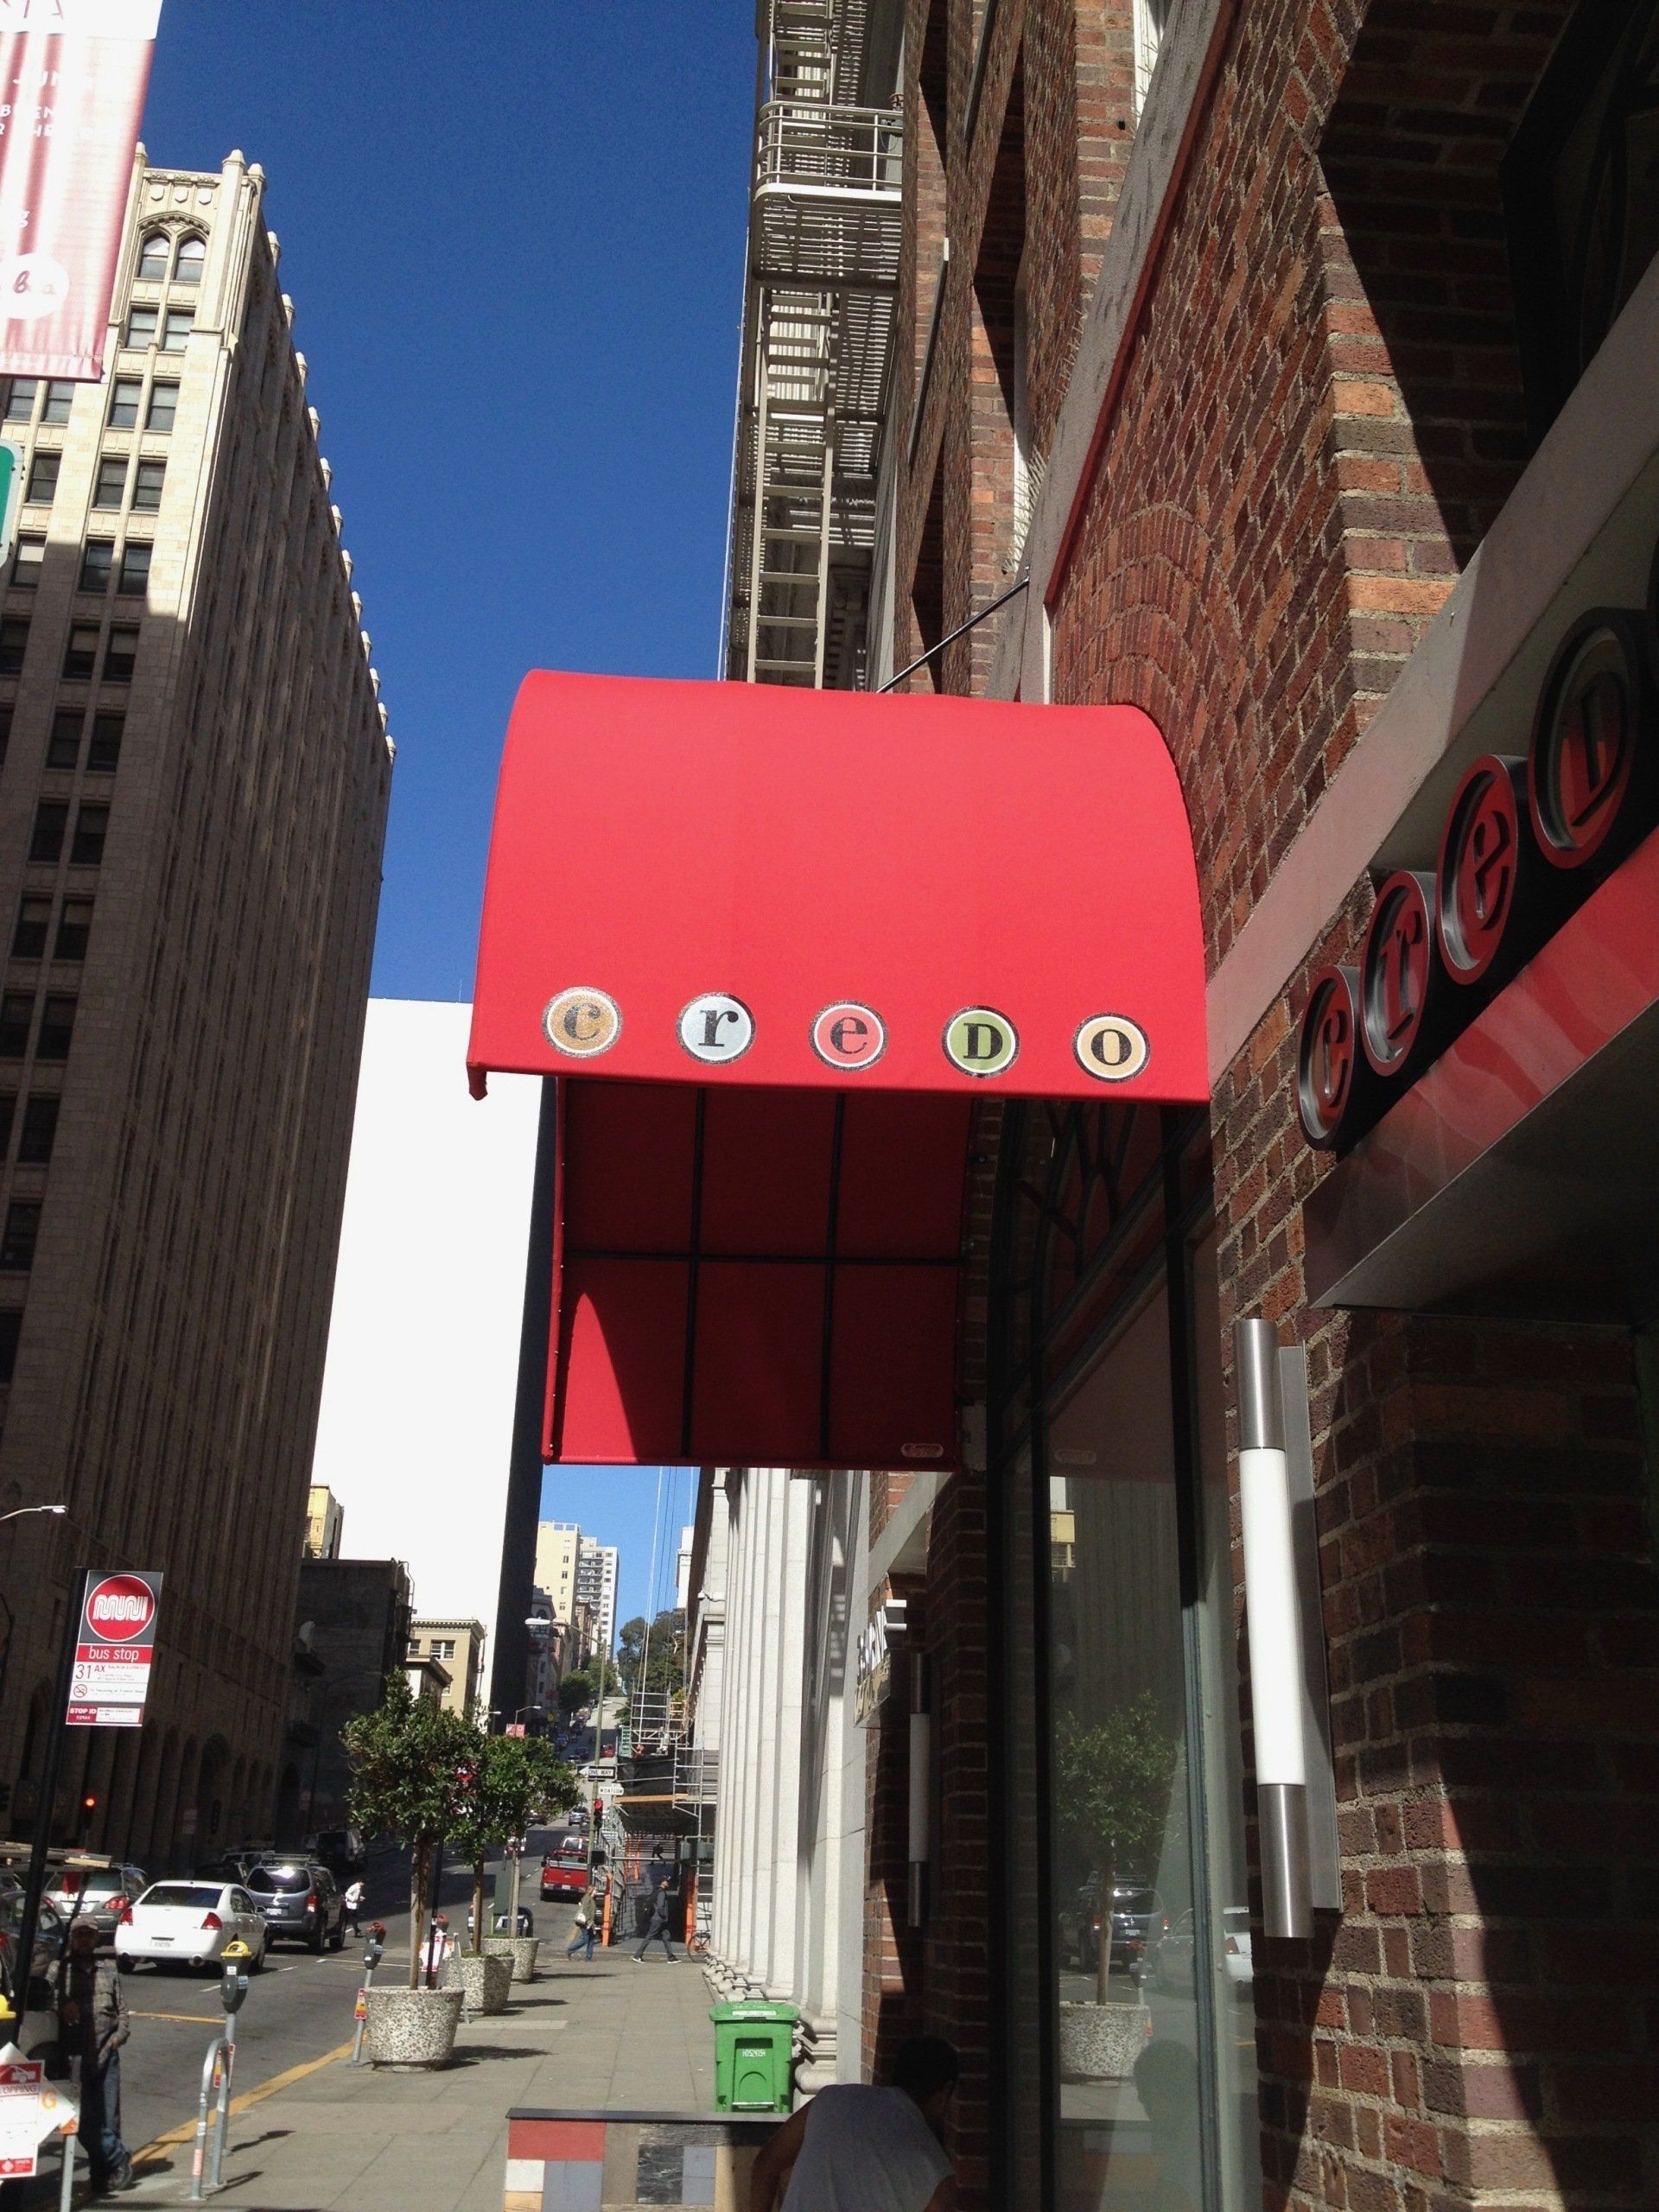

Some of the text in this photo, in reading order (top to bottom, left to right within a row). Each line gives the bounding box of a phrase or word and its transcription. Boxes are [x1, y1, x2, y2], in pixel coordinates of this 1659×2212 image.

[88, 1645, 139, 1663] bus stop
[75, 1663, 92, 1680] 31
[93, 1664, 105, 1673] AX
